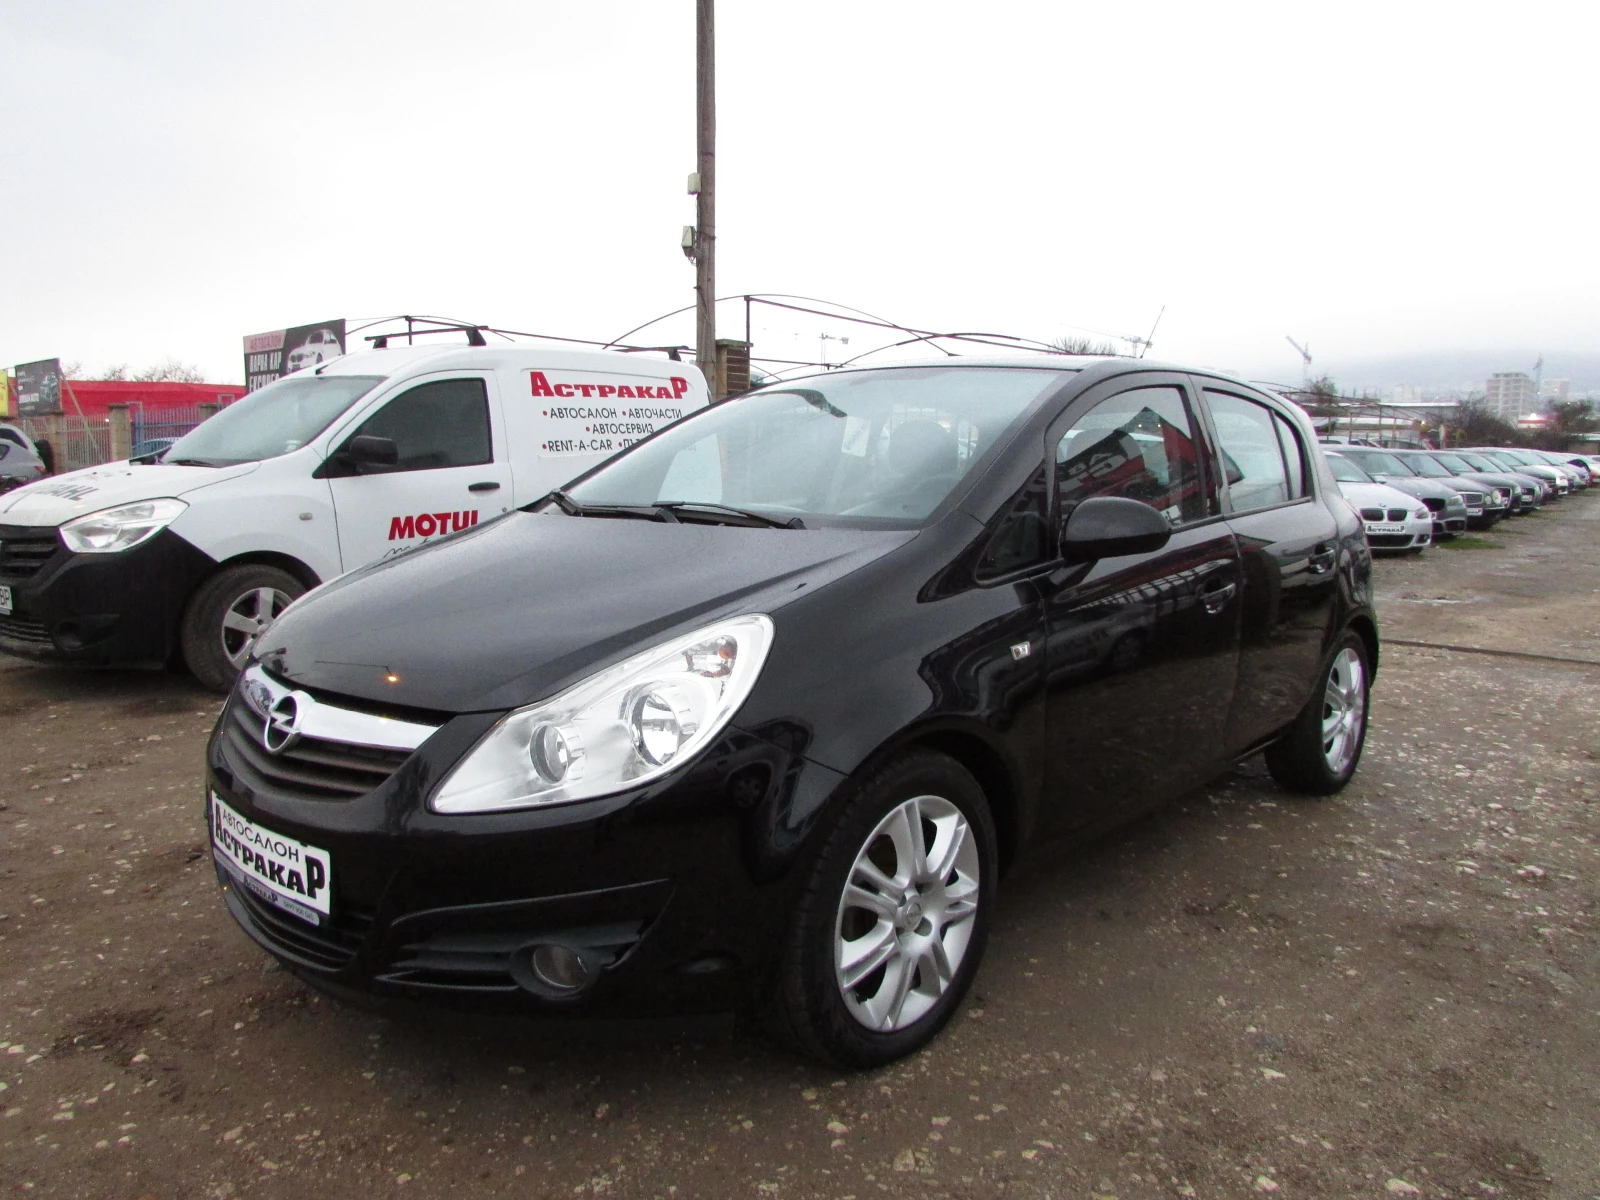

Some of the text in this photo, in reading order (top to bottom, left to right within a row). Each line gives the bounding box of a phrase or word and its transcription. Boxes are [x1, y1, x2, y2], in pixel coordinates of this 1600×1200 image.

[530, 371, 688, 399] АСТРАКАР
[550, 407, 683, 419] АВТОСАЛОН АВТОЧАСТИ
[592, 423, 654, 434] АВТОСЕРВИЗ
[547, 440, 613, 452] RENT-A-CAR
[222, 808, 300, 863] АВТОСАЛОН
[215, 802, 326, 900] АСТРАКАР
